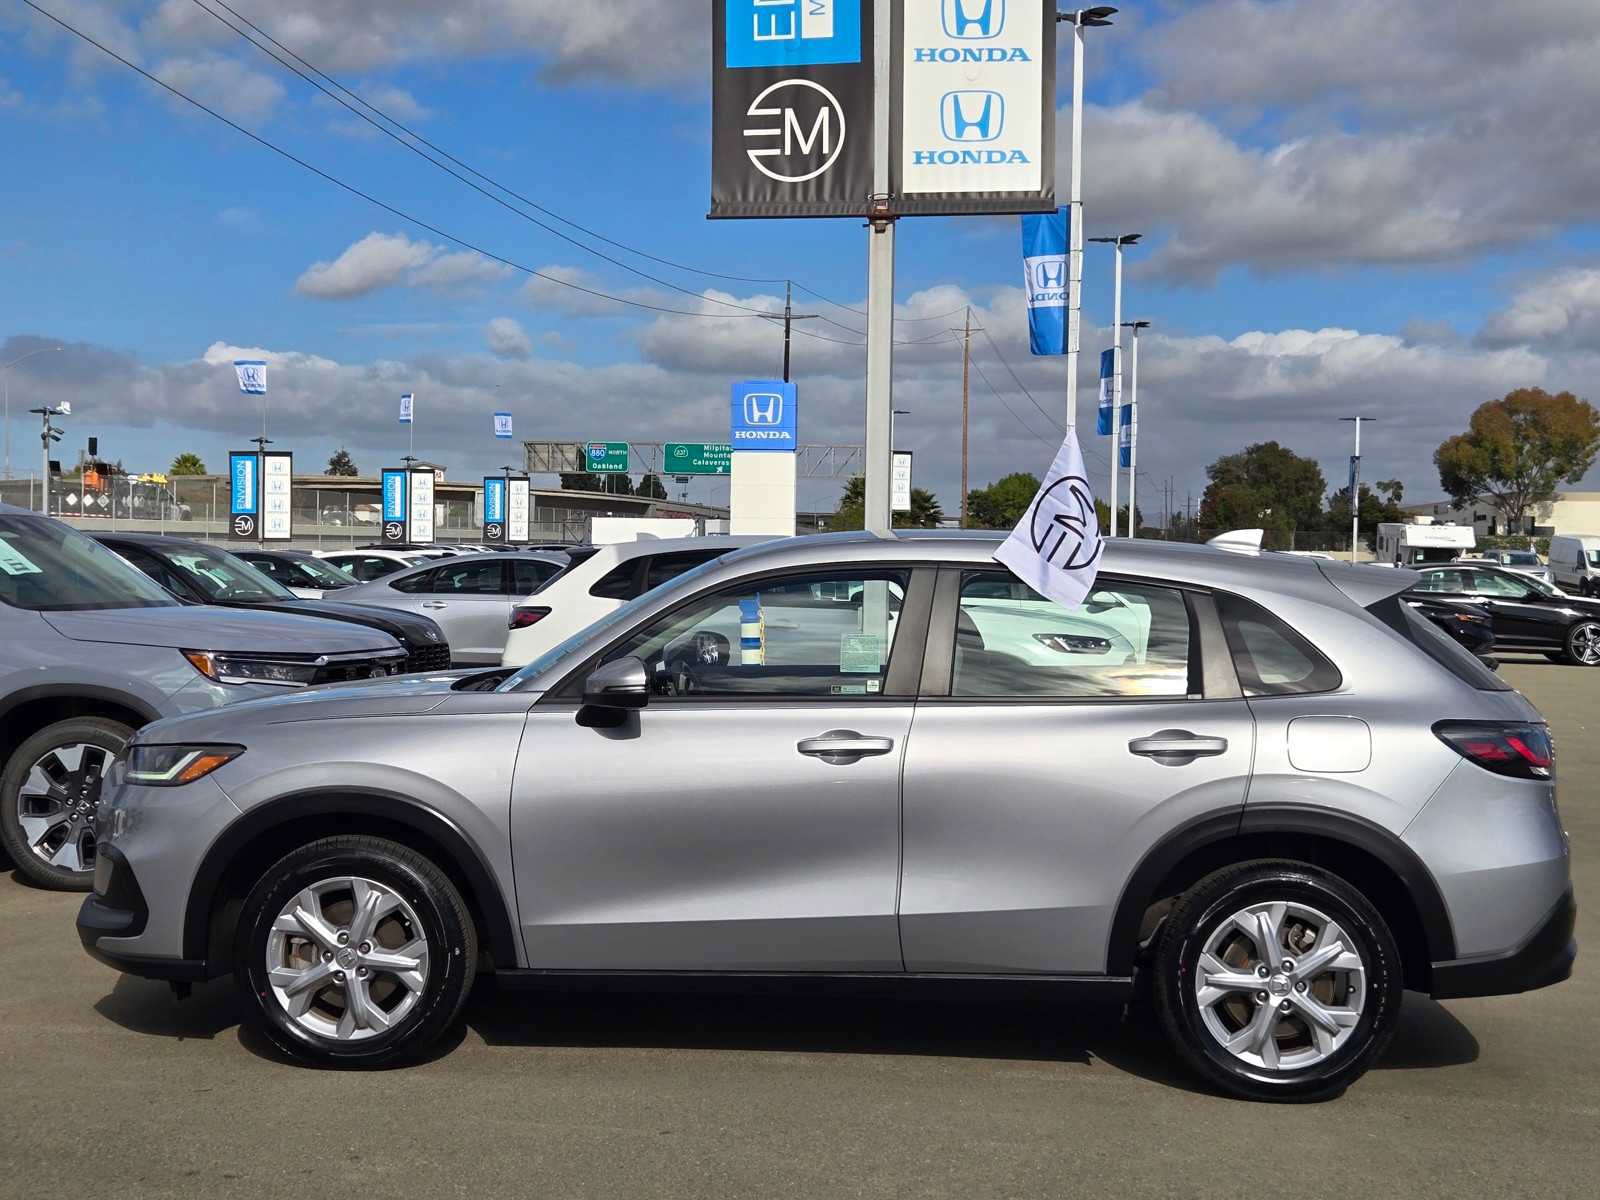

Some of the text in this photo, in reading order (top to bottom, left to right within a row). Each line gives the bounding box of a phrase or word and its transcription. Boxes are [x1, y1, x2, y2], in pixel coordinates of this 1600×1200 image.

[913, 47, 1032, 63] HONDA
[912, 149, 1031, 165] HONDA
[735, 431, 792, 439] HONDA
[591, 449, 605, 457] 880
[592, 462, 623, 470] Oakland
[692, 458, 731, 466] Calaveras
[236, 460, 247, 510] ENVISION
